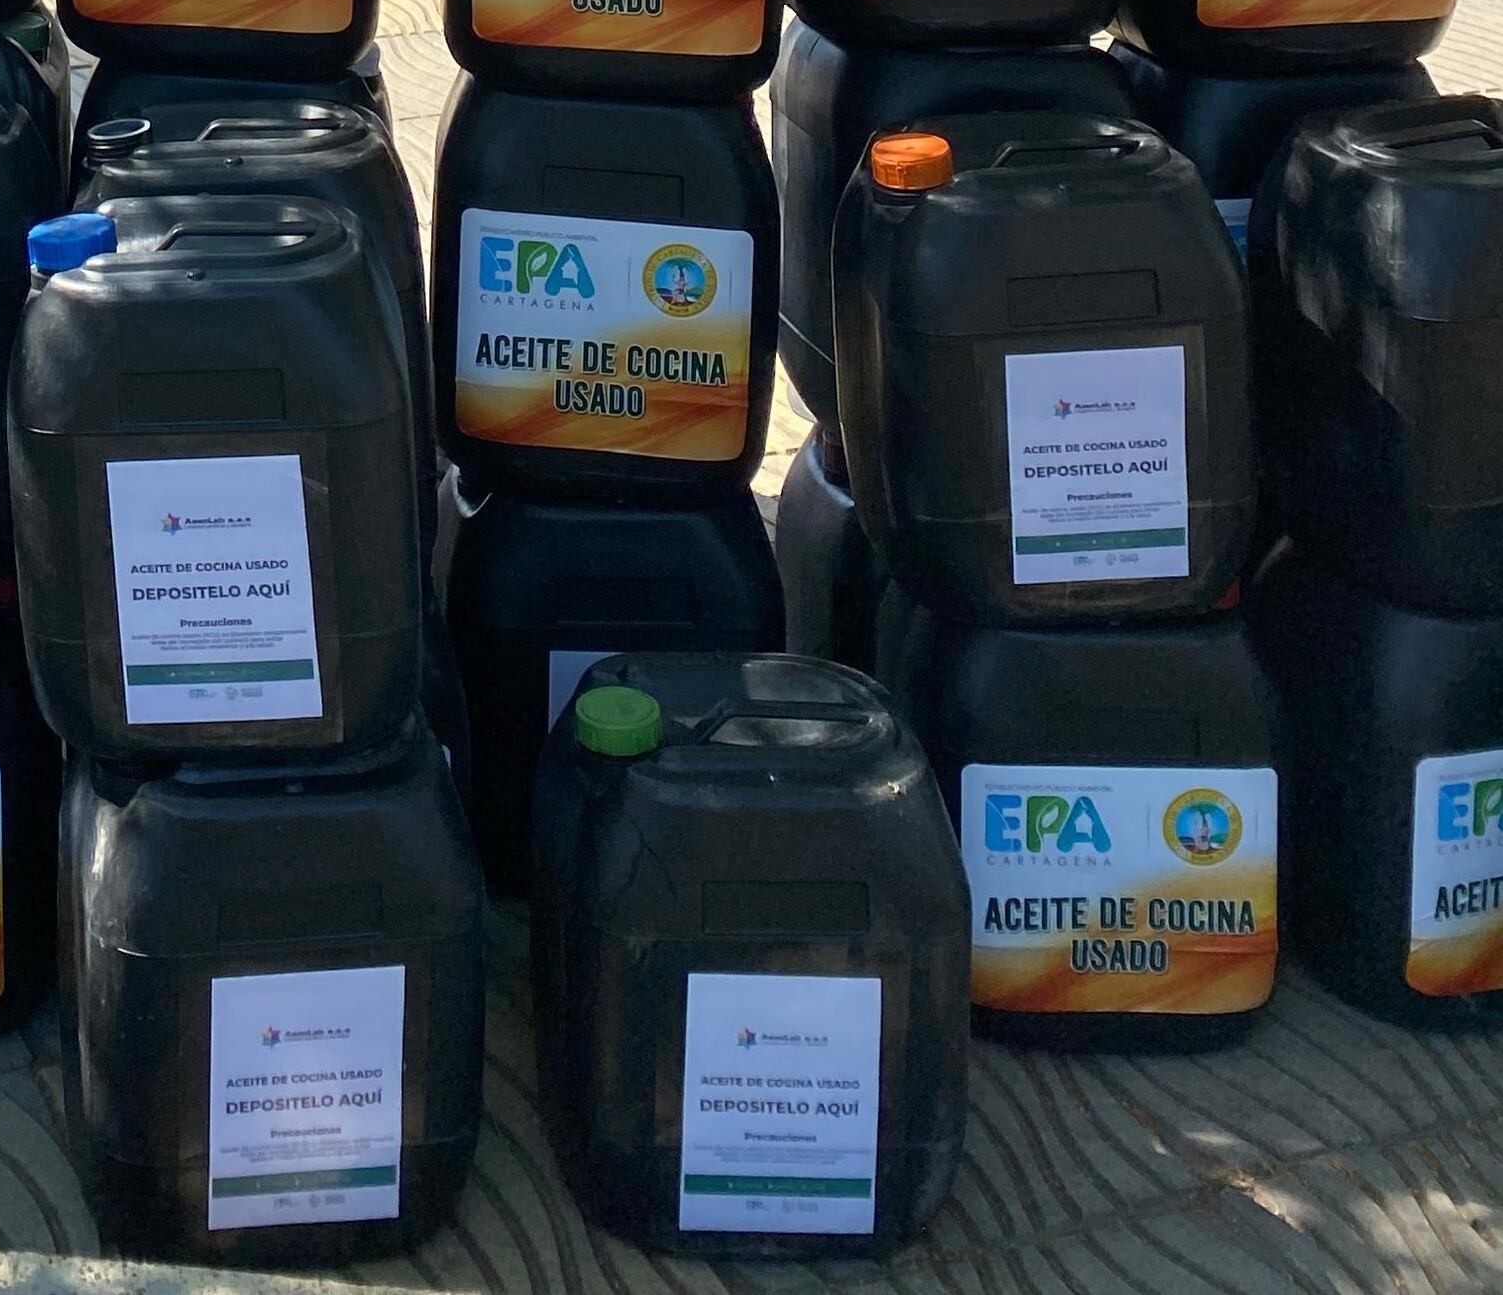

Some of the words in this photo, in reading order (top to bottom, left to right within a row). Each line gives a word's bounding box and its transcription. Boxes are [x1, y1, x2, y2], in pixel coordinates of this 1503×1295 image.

[480, 237, 595, 298] EPA
[480, 294, 595, 312] CARTAGENA
[476, 334, 571, 370] ACEITE
[583, 341, 615, 373] DE
[627, 346, 727, 384] COCINA
[556, 379, 644, 417] USADO
[1024, 445, 1061, 454] ACEITE
[1065, 444, 1080, 452] DE
[1084, 442, 1125, 451] COCINA
[1129, 439, 1167, 448] USADO
[1025, 462, 1124, 478] DEPOSITELO
[1129, 458, 1167, 473] AQUÍ
[1067, 492, 1132, 502] Precauciones
[131, 564, 172, 574] ACEITE
[176, 563, 192, 572] DE
[196, 562, 242, 571] COCINA
[246, 560, 288, 570] USADO
[133, 585, 241, 600] DEPOSITELO
[247, 580, 290, 599] AQUÍ
[180, 618, 252, 628] Precauciones
[1438, 778, 1503, 841] EP
[985, 794, 1111, 852] EPA
[987, 856, 1112, 866] CARTAGENA
[1435, 877, 1503, 920] ACEIT
[984, 897, 1087, 931] ACEITE
[1100, 897, 1135, 931] DE
[1149, 898, 1254, 933] COCINA
[1072, 939, 1167, 971] USADO
[227, 1077, 268, 1088] ACEITE
[272, 1076, 287, 1085] DE
[291, 1072, 336, 1084] COCINA
[341, 1069, 383, 1080] USADO
[702, 1077, 743, 1086] ACEITE
[747, 1078, 763, 1087] DE
[767, 1078, 813, 1088] COCINA
[817, 1080, 860, 1089] USADO
[226, 1095, 333, 1114] DEPOSITELO
[339, 1089, 382, 1109] AQUÍ
[700, 1099, 809, 1115] DEPOSITELO
[816, 1100, 859, 1117] AQUÍ
